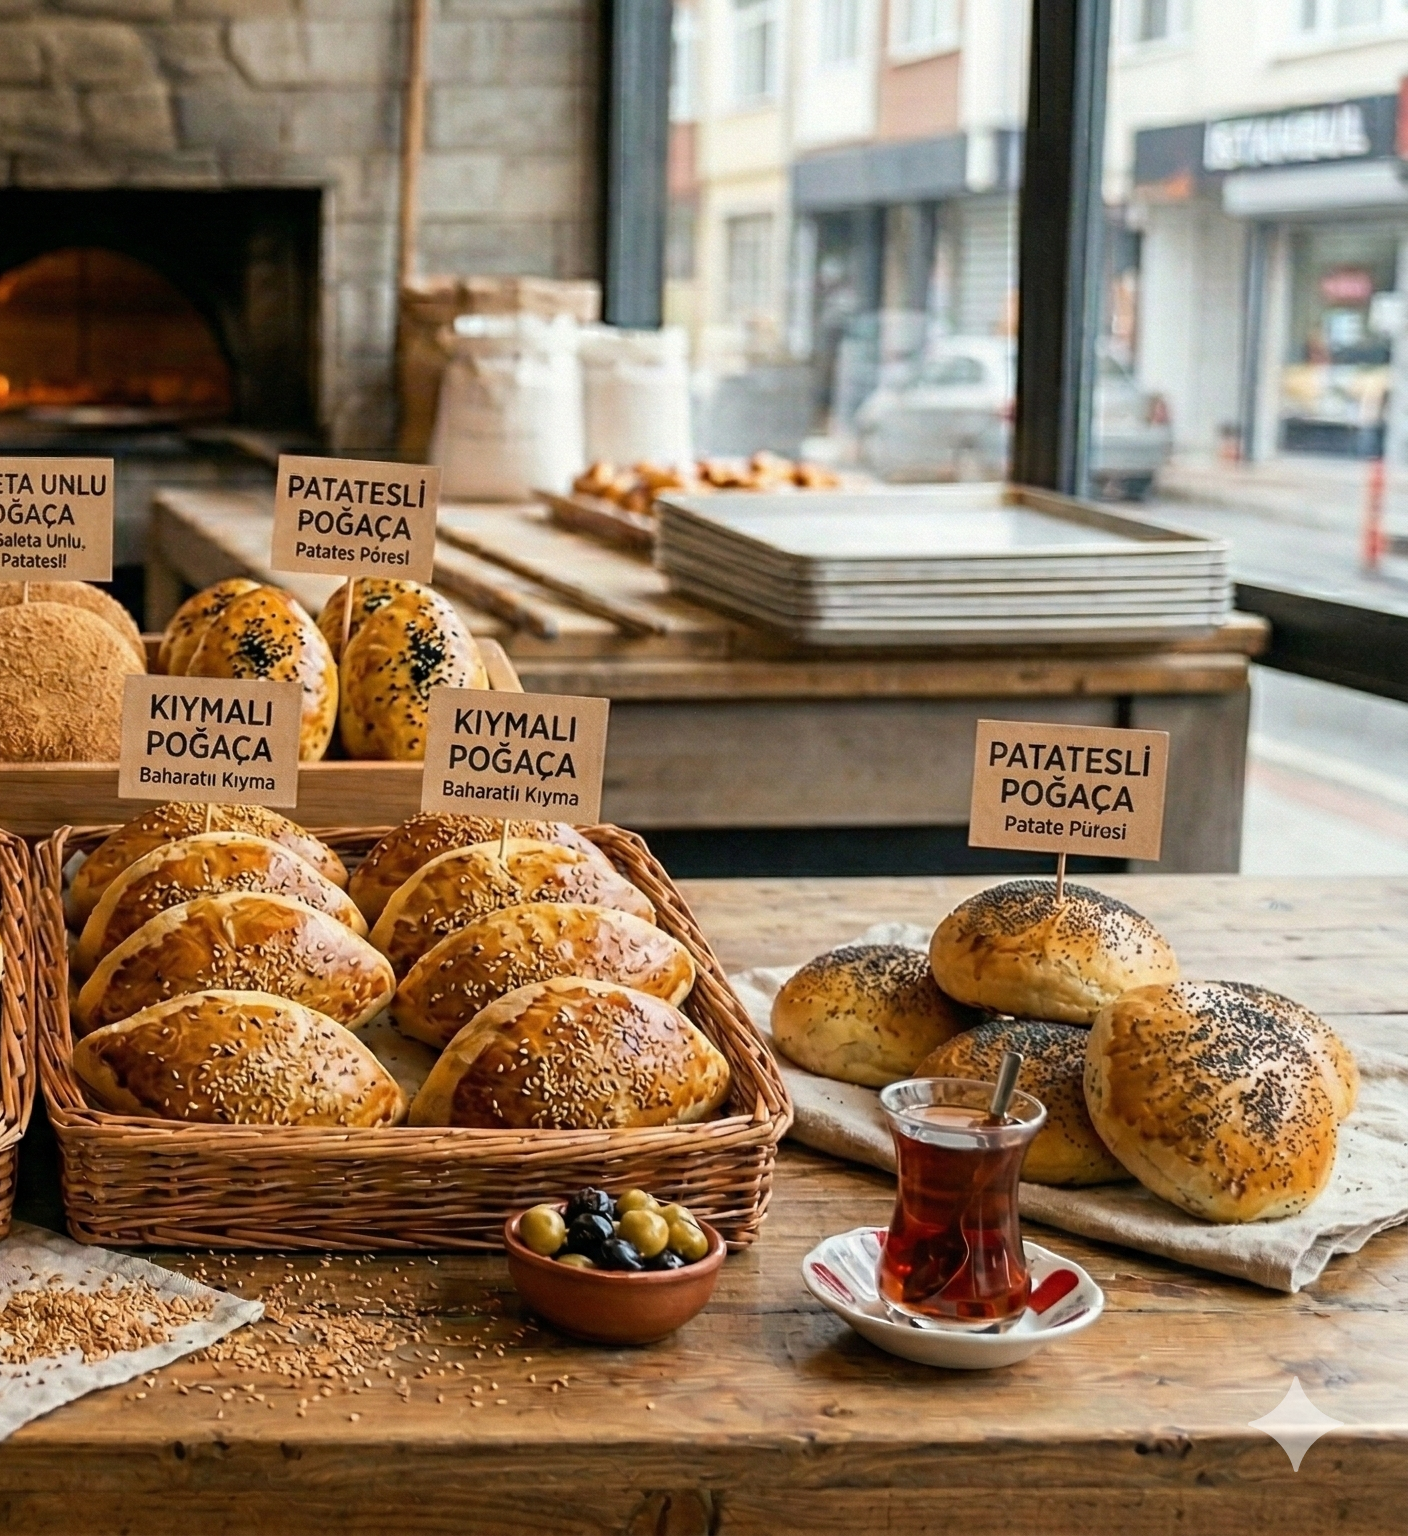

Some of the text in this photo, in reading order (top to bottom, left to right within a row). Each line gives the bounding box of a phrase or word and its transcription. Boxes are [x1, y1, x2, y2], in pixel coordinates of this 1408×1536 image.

[41, 474, 106, 496] UNLU
[288, 474, 426, 508] PATATESLİ
[297, 506, 412, 542] POĞAÇA
[295, 541, 355, 562] Patates
[150, 693, 272, 726] KIYMALI
[454, 708, 577, 742] KIYMALI
[146, 726, 273, 766] POĞAÇA
[449, 741, 577, 781] POĞAÇA
[989, 740, 1151, 777] PATATESLİ
[222, 772, 276, 792] Kıyma
[525, 786, 579, 807] Kıyma
[1001, 775, 1135, 815] POĞAÇA
[1004, 815, 1127, 840] Patate Püresi
